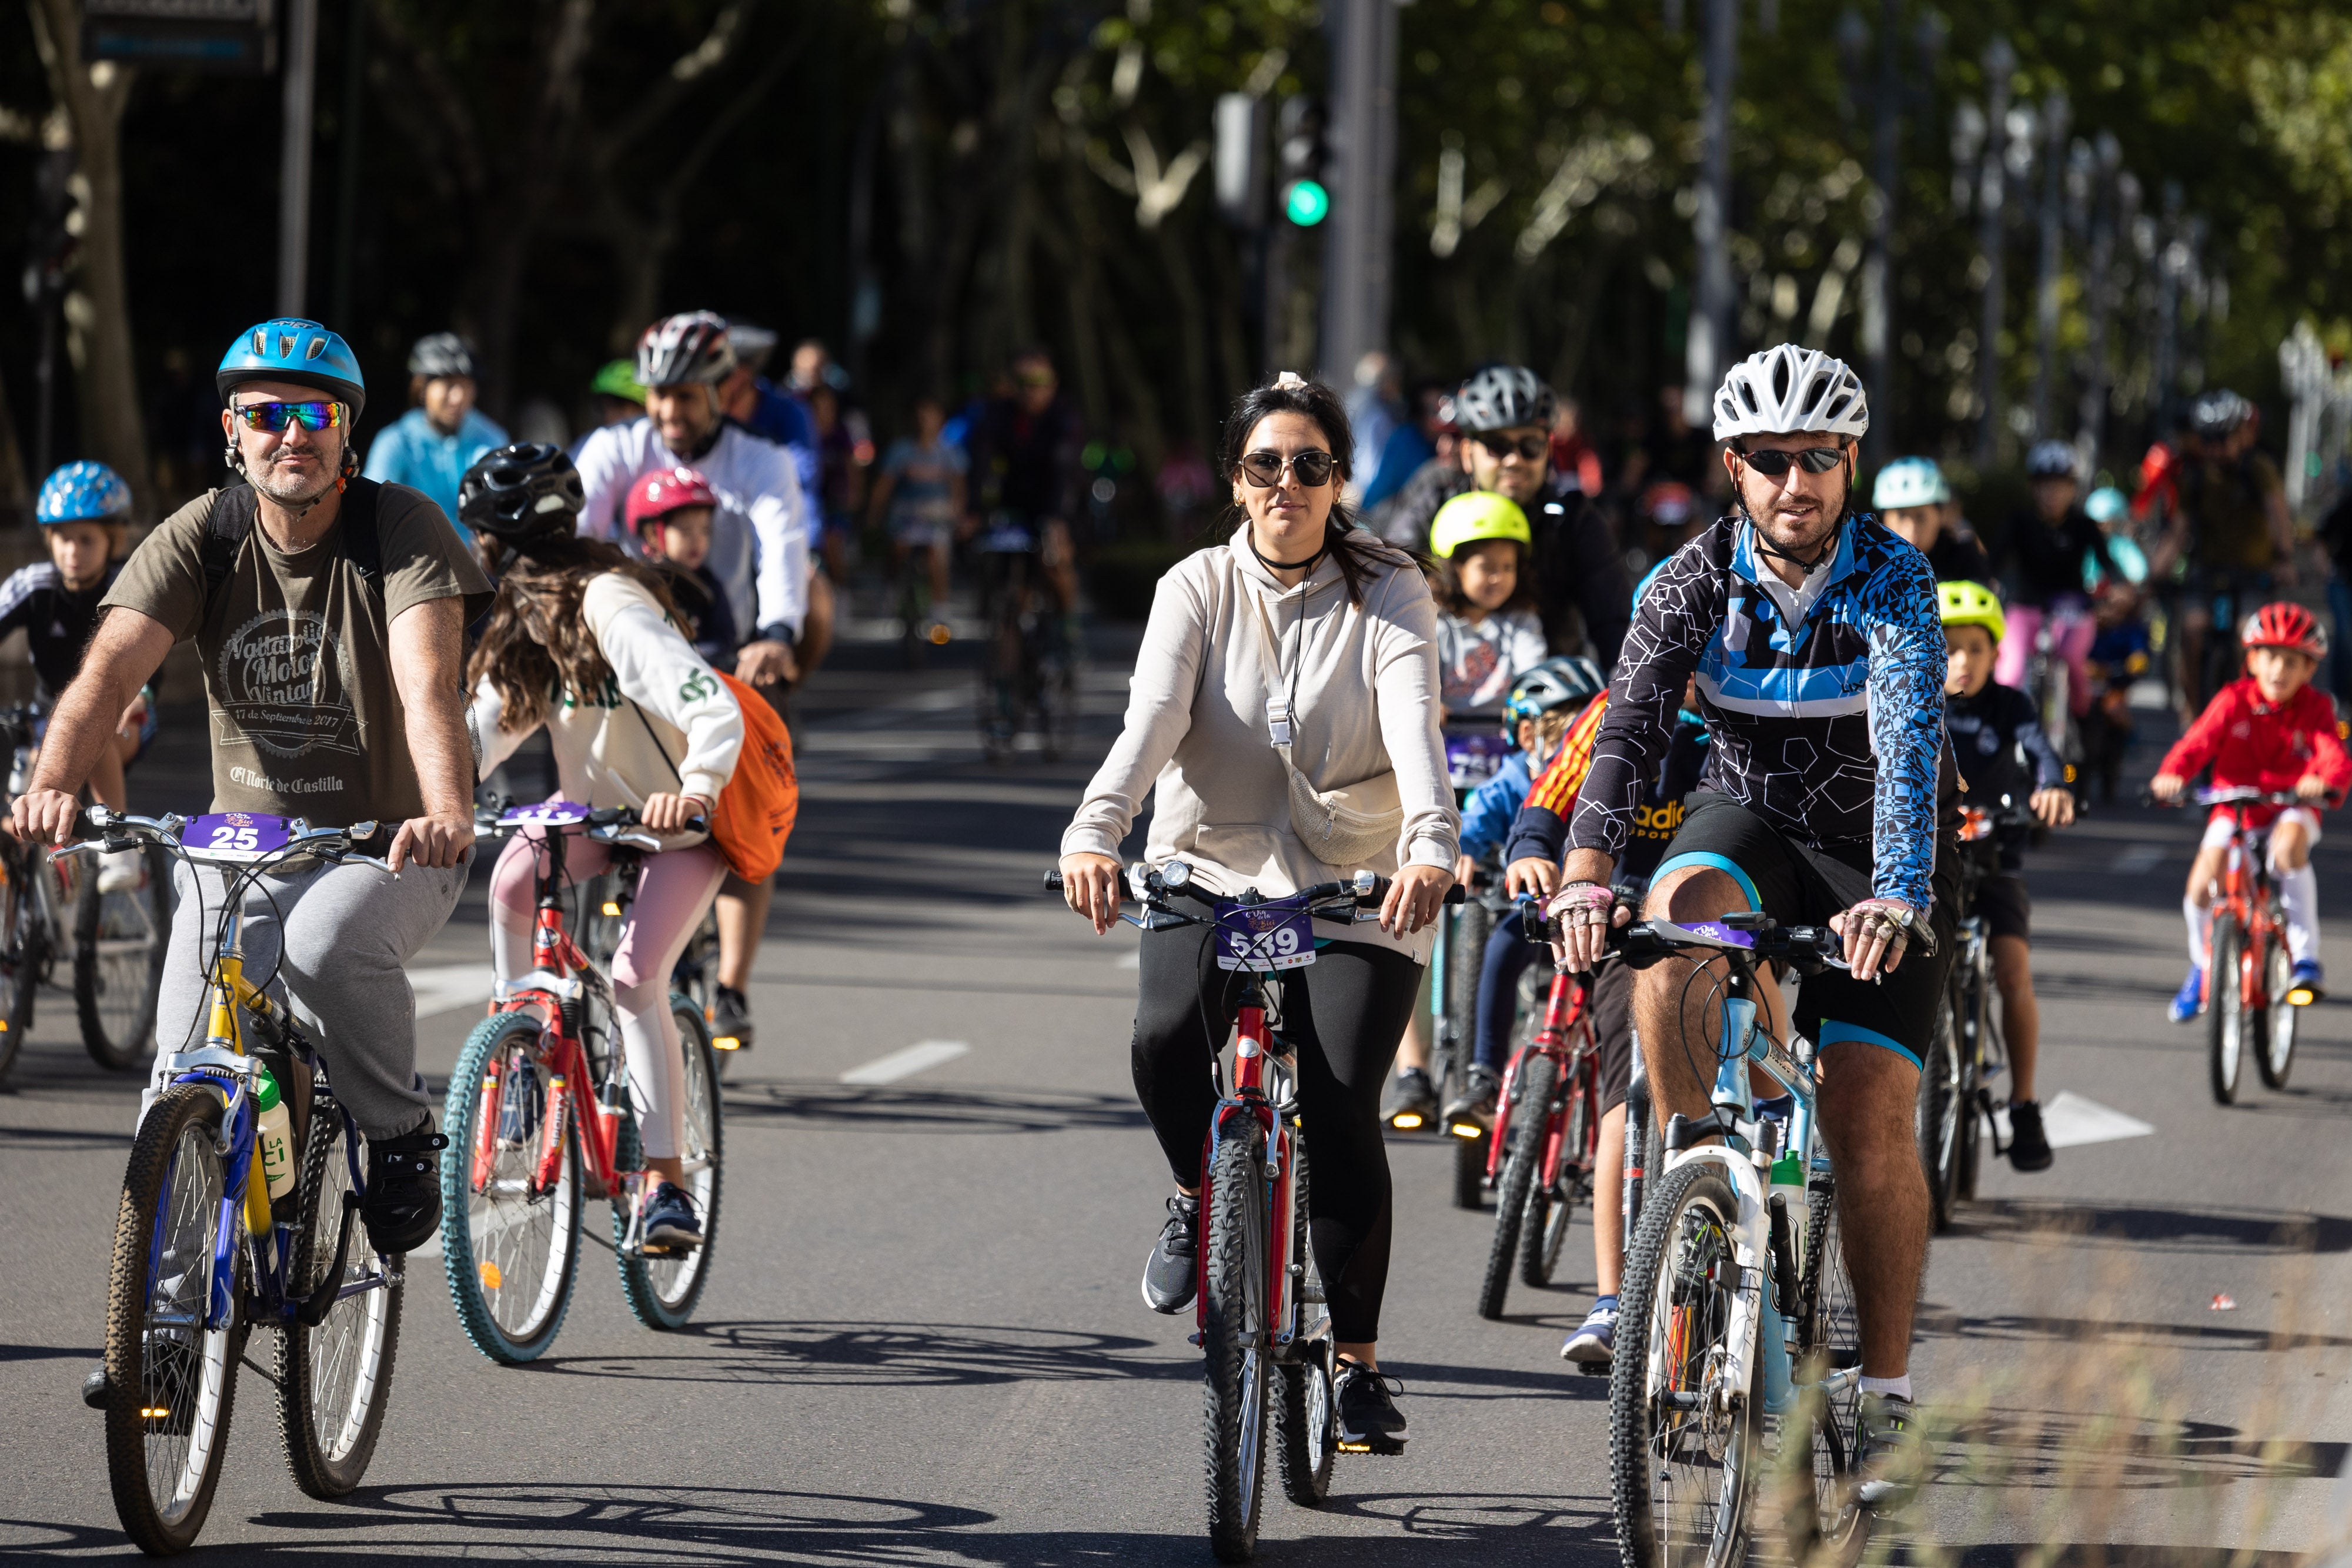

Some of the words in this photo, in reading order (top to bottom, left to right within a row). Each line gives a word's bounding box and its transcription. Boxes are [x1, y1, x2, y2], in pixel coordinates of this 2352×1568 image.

[249, 680, 314, 705] Vintag
[680, 667, 718, 706] 95
[235, 709, 245, 719] 17
[248, 710, 259, 720] de
[313, 714, 339, 727] 2017
[230, 766, 245, 784] El
[246, 769, 275, 791] Norte
[276, 778, 289, 793] de
[291, 775, 343, 794] Castilla
[208, 827, 259, 851] 25
[1230, 927, 1299, 959] 539
[1739, 1028, 1750, 1080] MMR
[550, 1092, 566, 1148] SPORTY
[269, 1137, 283, 1149] LA
[1743, 1273, 1760, 1352] RST
[1741, 1469, 1757, 1533] RALPH
